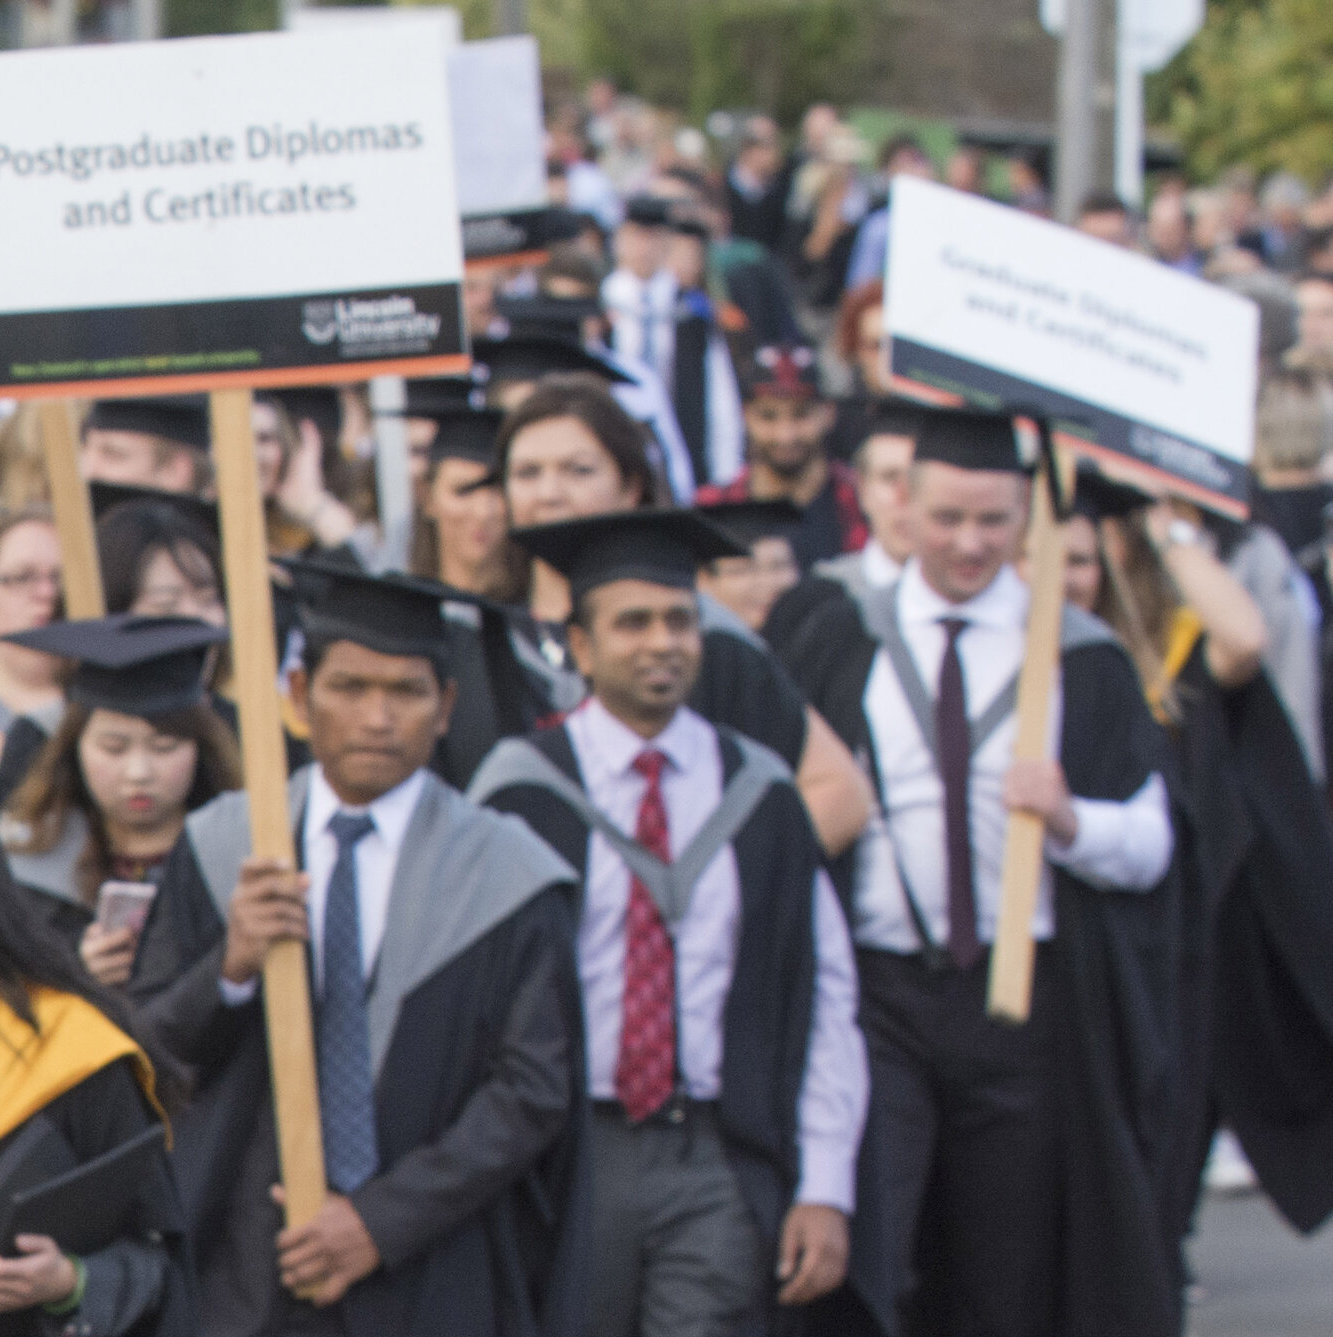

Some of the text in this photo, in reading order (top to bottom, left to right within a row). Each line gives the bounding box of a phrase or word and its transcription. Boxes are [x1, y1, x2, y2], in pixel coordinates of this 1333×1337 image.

[245, 119, 424, 166] Diplomas
[63, 180, 357, 230] and Certificates
[335, 294, 416, 319] Lincoln
[965, 294, 1019, 325] and
